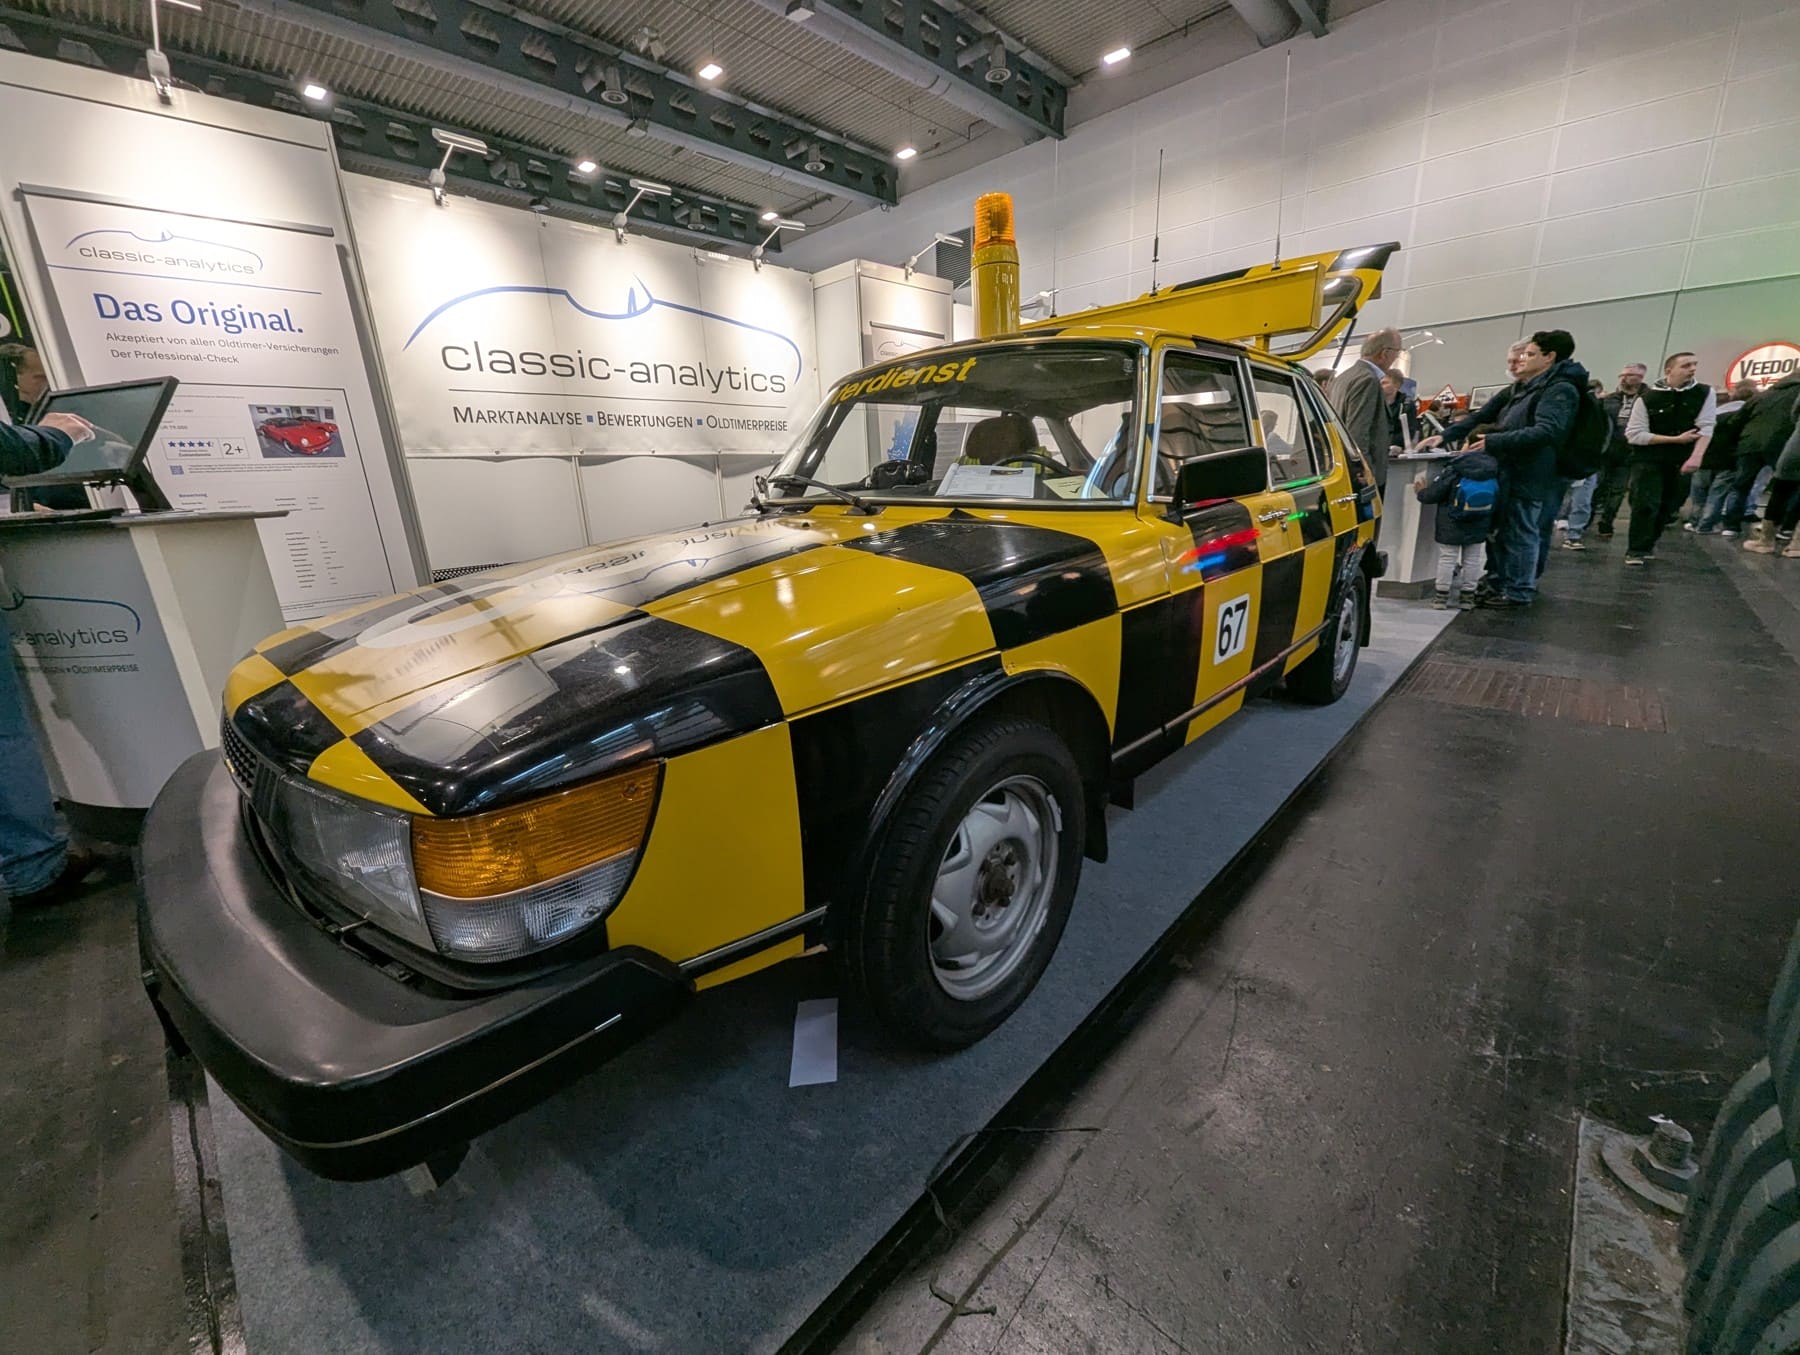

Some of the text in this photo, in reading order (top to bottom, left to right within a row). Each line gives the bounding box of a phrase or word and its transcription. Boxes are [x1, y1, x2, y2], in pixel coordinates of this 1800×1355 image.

[79, 246, 255, 275] classic-analytics
[93, 293, 304, 335] Das Original.
[106, 332, 340, 356] Akzeptiert von allen Oldtimer-Versicherungen
[110, 349, 240, 364] Der Professional-Check
[441, 341, 786, 394] classic-analytics
[453, 406, 788, 432] MARKTANALYSE BEWERTUNGEN OLDTIMERPREISE
[223, 442, 244, 456] 2+
[1218, 600, 1248, 657] 67
